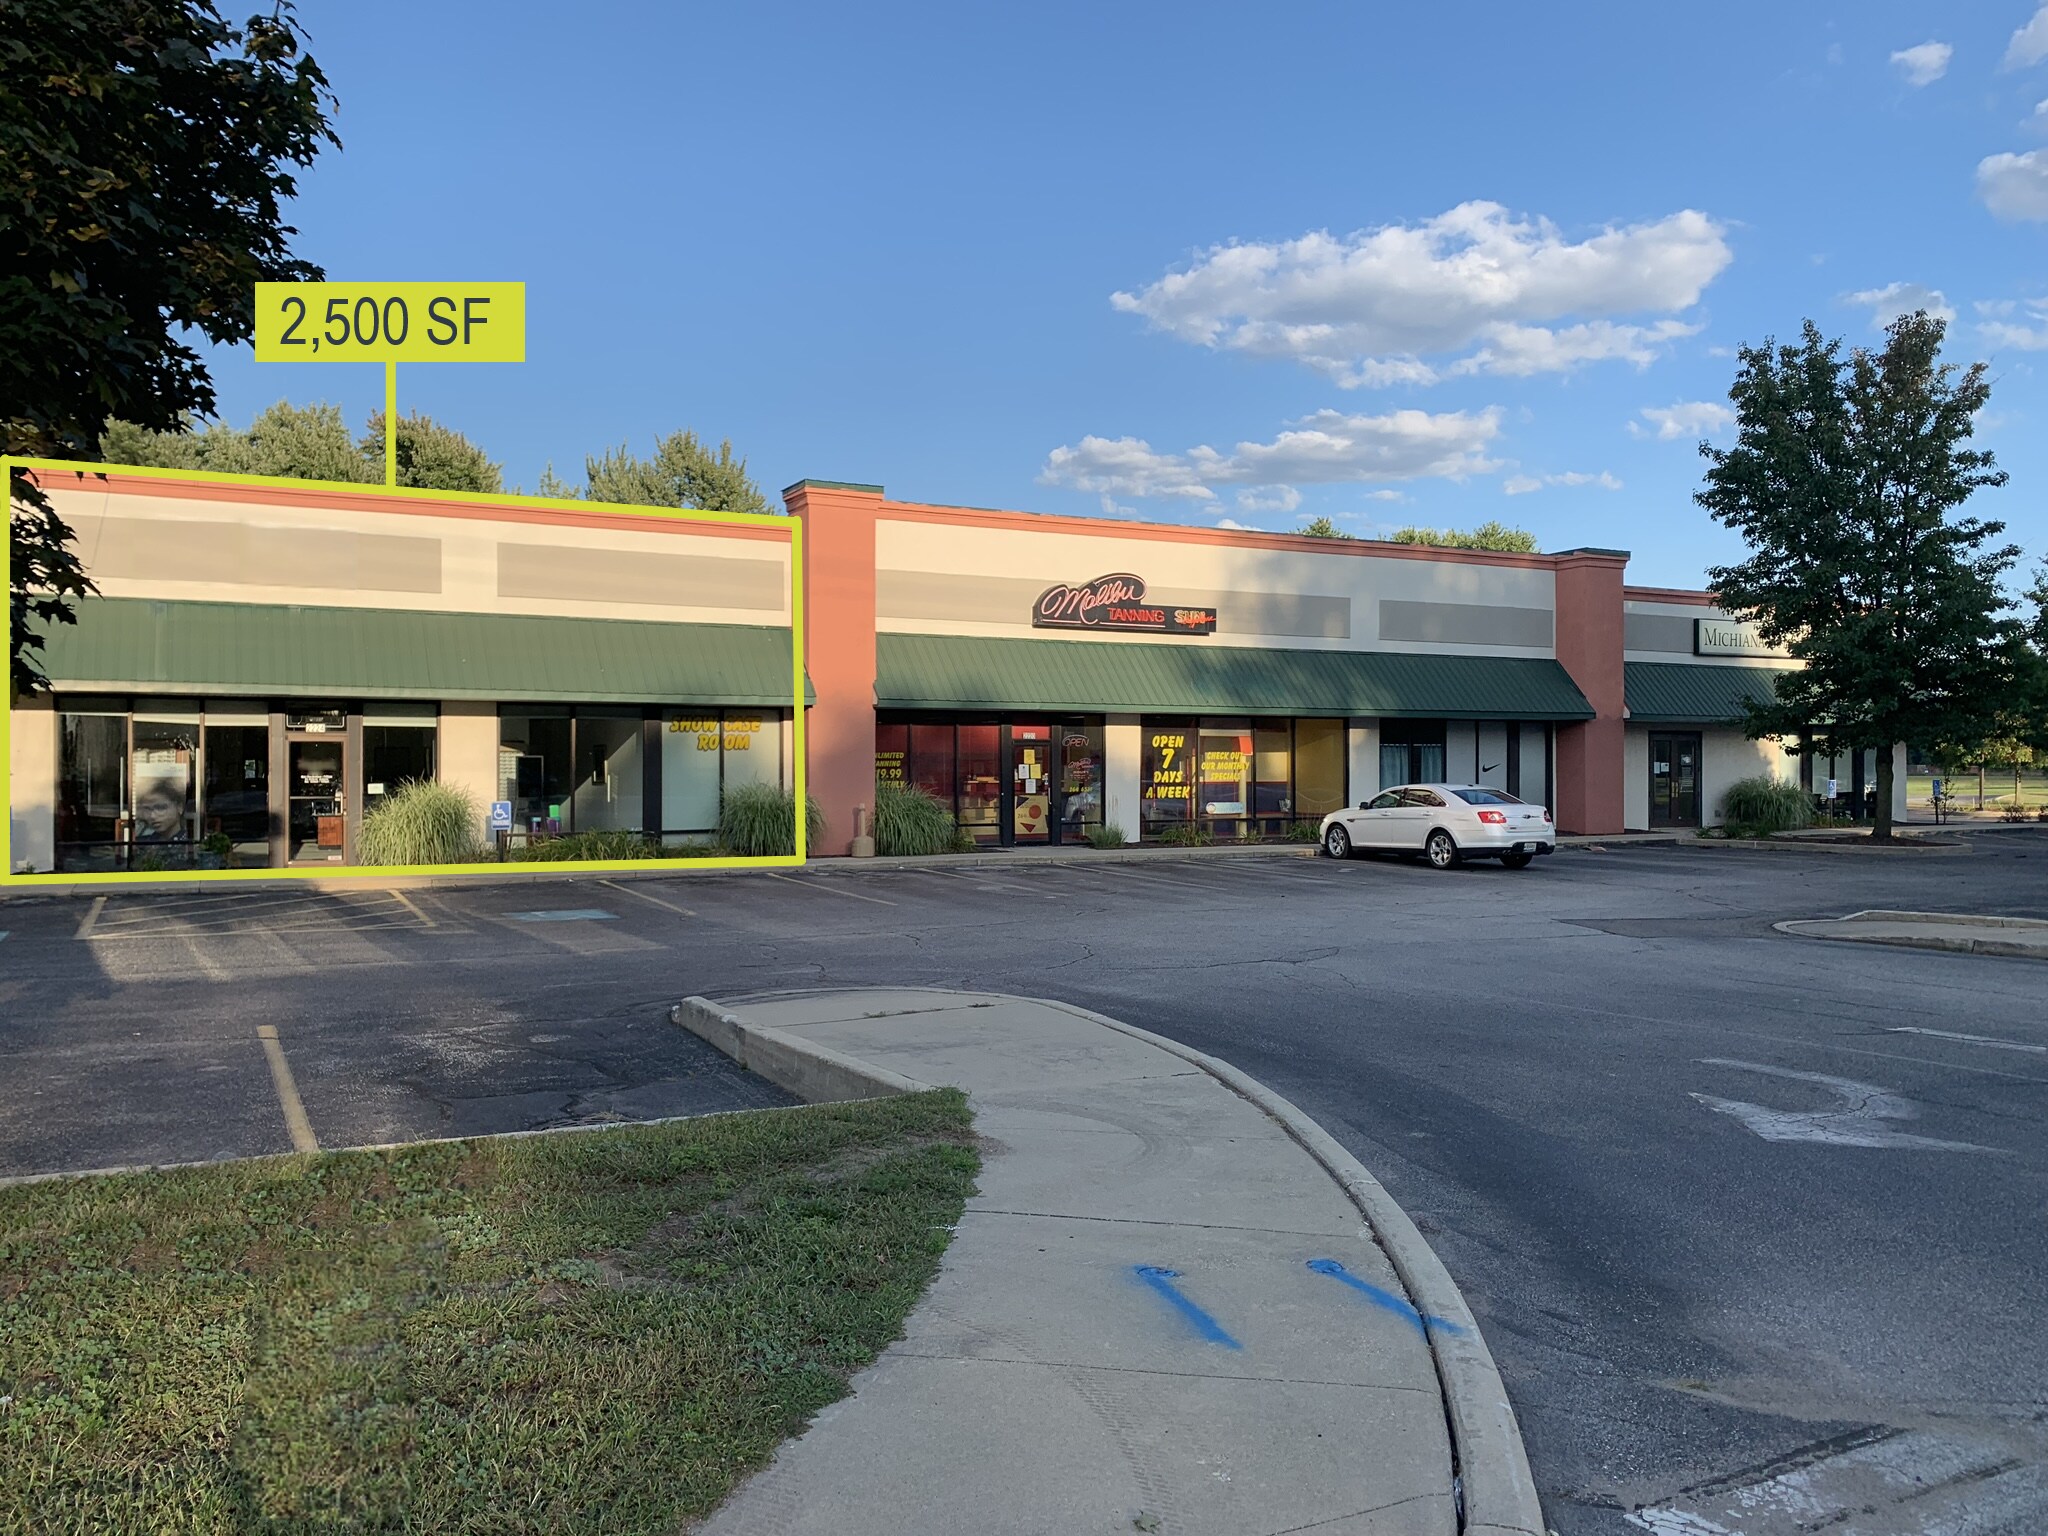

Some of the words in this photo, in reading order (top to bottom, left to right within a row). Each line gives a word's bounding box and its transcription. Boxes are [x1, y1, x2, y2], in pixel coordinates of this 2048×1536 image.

[1040, 574, 1147, 625] Malibu
[1107, 607, 1165, 623] TANNING
[1704, 628, 1766, 648] MICHIANA
[669, 715, 718, 733] SHOW
[723, 716, 763, 733] CASE
[697, 734, 751, 751] ROOM
[1062, 736, 1090, 747] OPEN
[1152, 735, 1184, 748] OPEN
[1162, 748, 1175, 769] 7
[1207, 751, 1230, 760] CHECK
[1230, 751, 1243, 760] OUT
[1201, 762, 1216, 770] OUR
[1217, 762, 1250, 770] MONTHLY
[1153, 770, 1184, 783] DAYS
[1211, 772, 1241, 781] SPECIALS
[1146, 786, 1153, 799] A
[1157, 786, 1191, 799] WEEK
